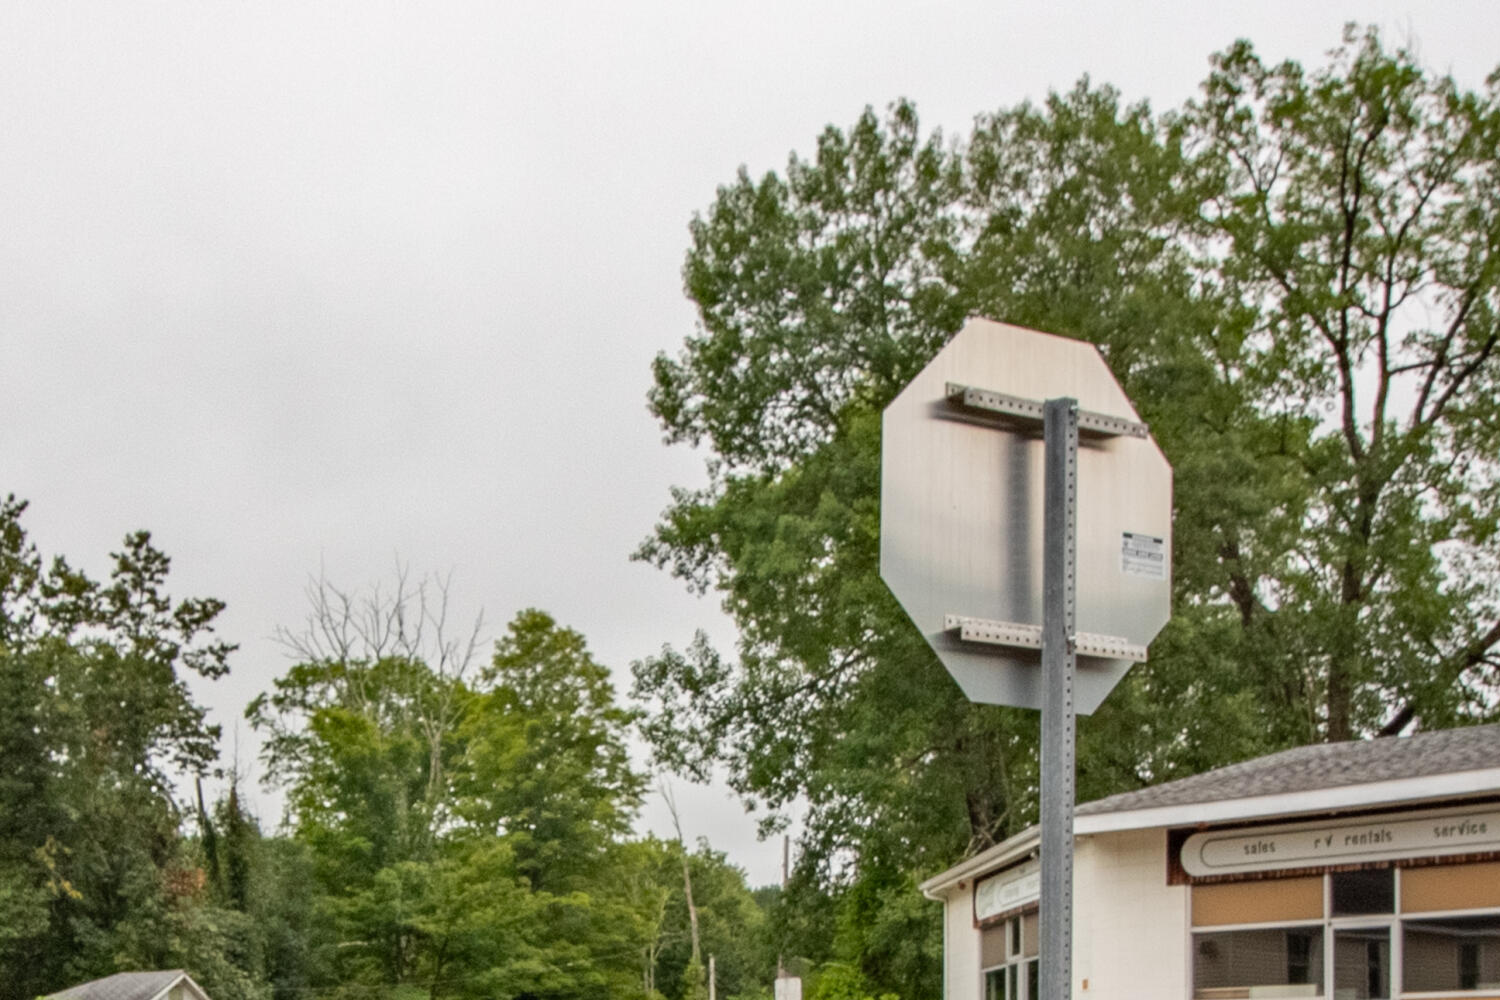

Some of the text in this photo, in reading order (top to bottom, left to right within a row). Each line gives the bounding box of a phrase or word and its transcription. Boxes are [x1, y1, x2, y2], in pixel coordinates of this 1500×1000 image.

[1244, 841, 1276, 855] sales
[1344, 829, 1392, 846] rentals
[1433, 820, 1488, 838] service
